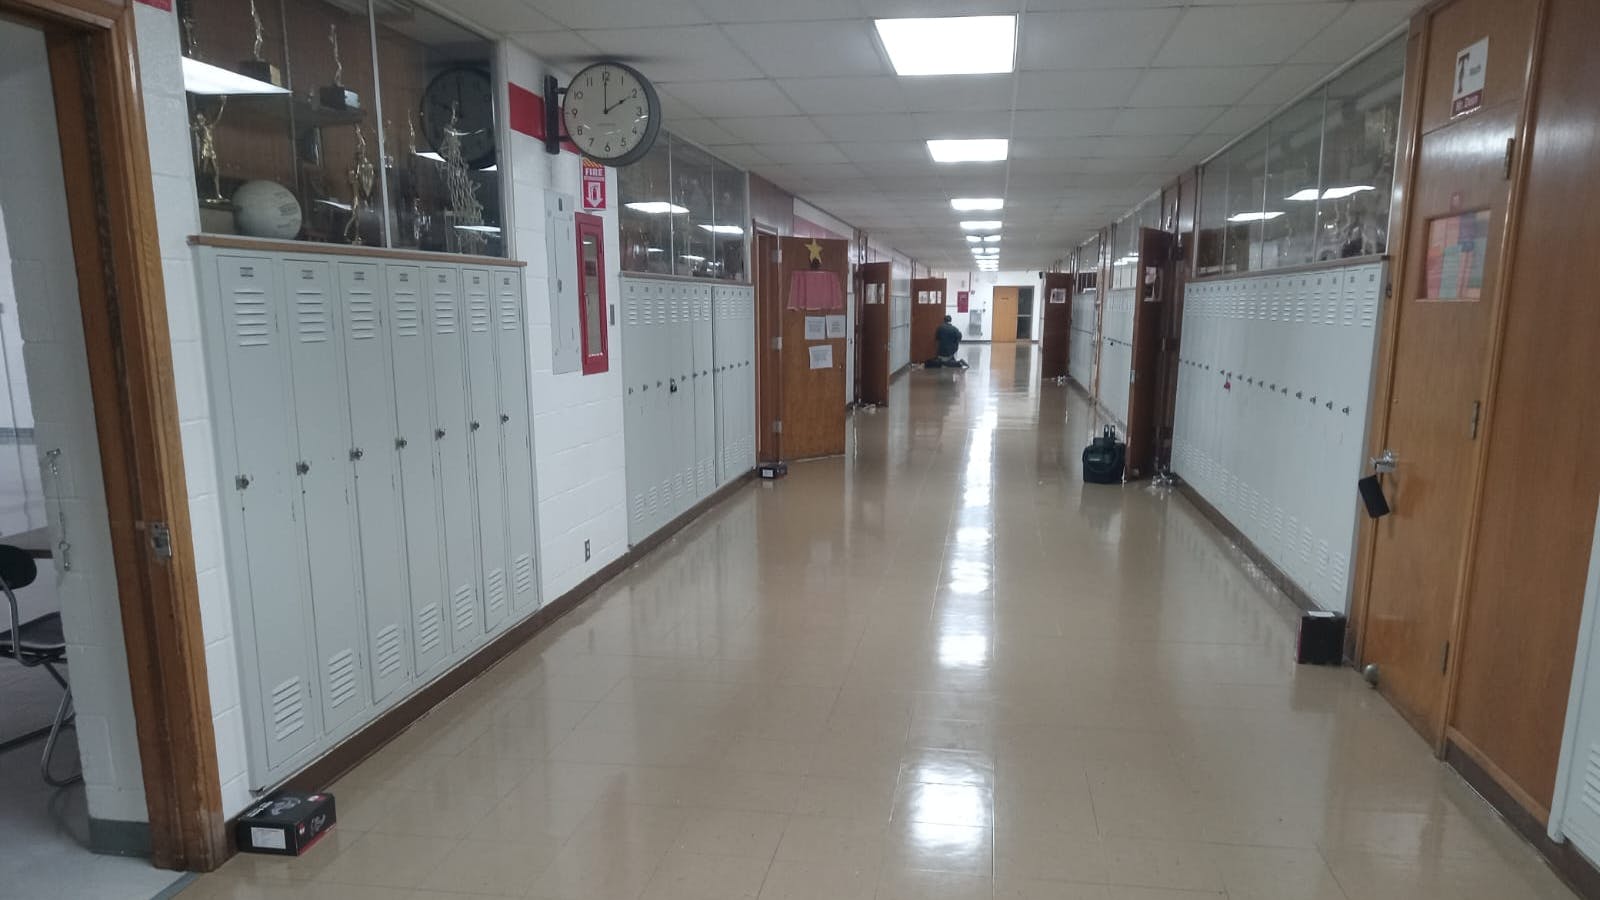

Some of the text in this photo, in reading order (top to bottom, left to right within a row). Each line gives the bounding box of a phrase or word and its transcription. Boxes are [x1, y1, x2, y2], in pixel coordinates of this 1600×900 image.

[586, 76, 593, 87] 11
[602, 72, 610, 81] 12
[573, 91, 584, 100] 10
[631, 88, 638, 99] 2
[571, 108, 578, 118] 9
[636, 106, 642, 117] 3
[577, 126, 583, 136] 8
[631, 126, 638, 135] 4
[588, 137, 594, 147] 7
[620, 137, 627, 147] 5
[604, 143, 611, 153] 6
[585, 168, 603, 176] FIRE
